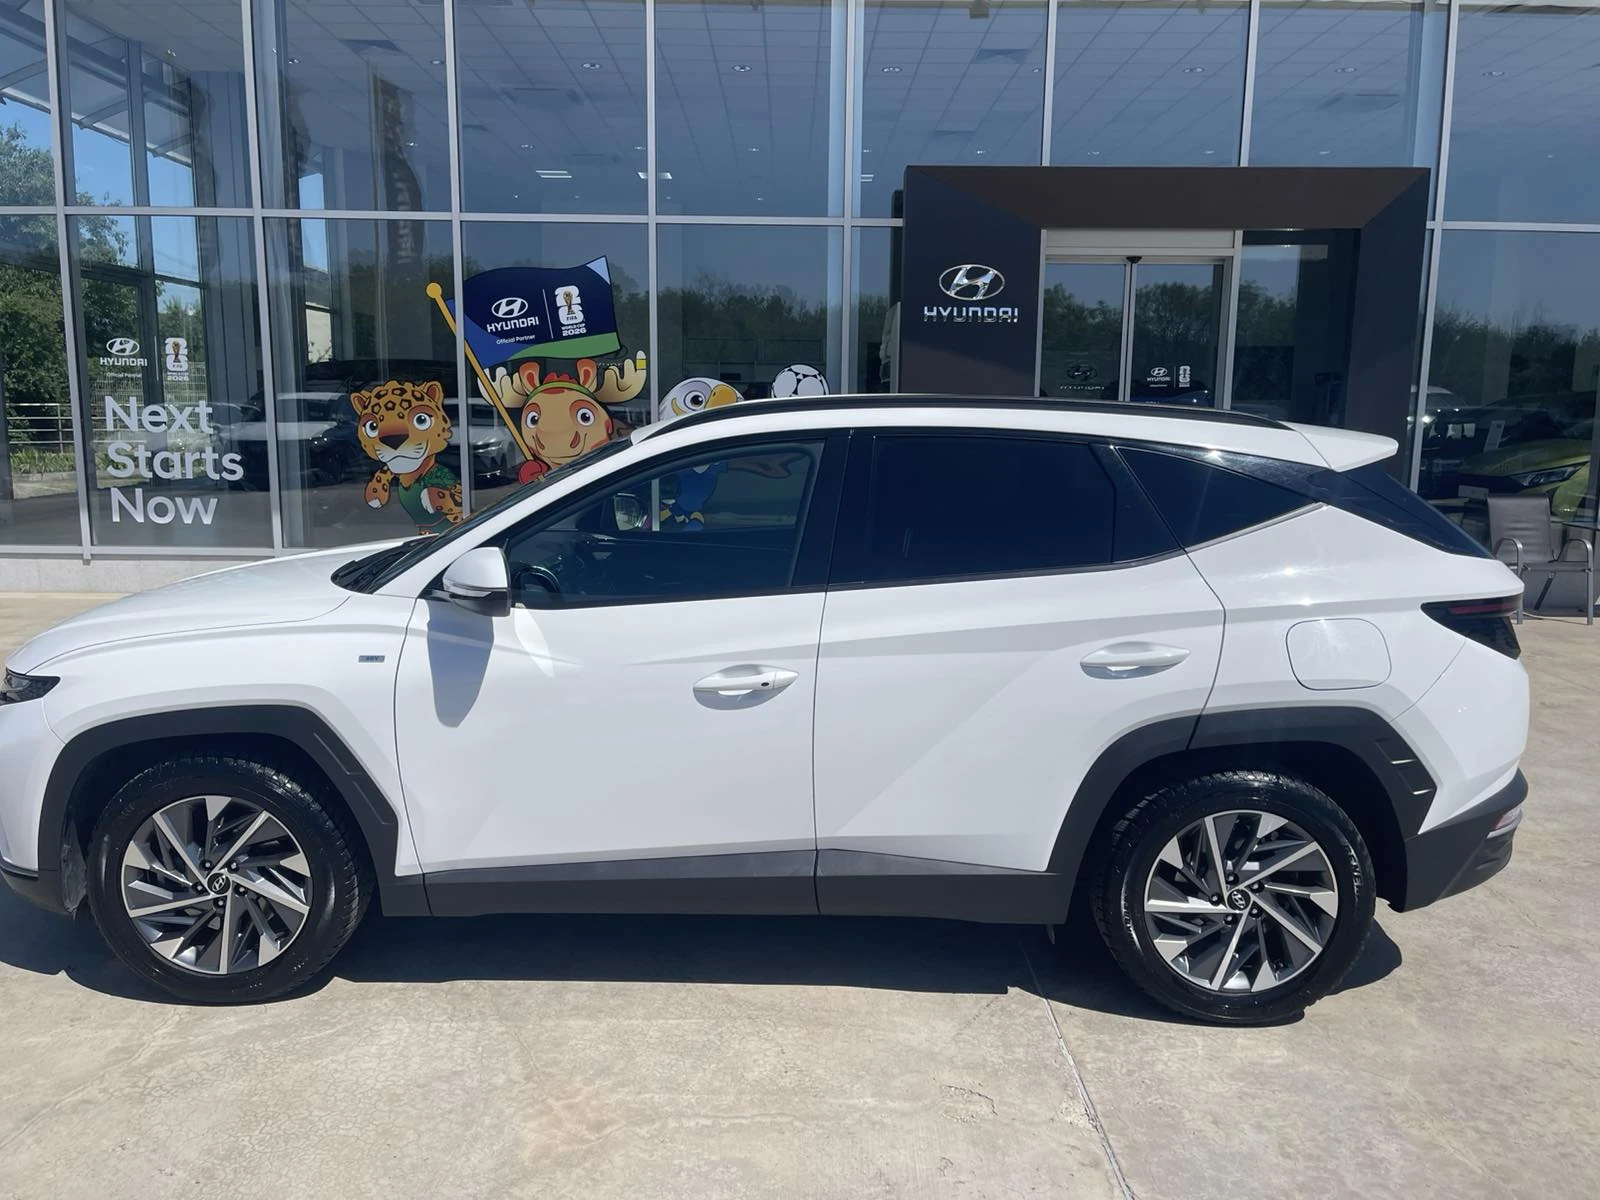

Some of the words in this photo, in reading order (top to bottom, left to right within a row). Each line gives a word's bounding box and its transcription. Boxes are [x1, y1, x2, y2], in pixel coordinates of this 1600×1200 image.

[923, 306, 1019, 323] HYUNDAI
[487, 316, 540, 333] HYUNDAI
[562, 327, 587, 336] 2026
[496, 336, 515, 345] Official
[516, 334, 535, 342] Partner
[100, 356, 148, 367] HYUNDAI
[105, 396, 213, 434] Next
[106, 441, 244, 481] Starts
[110, 487, 218, 525] Now
